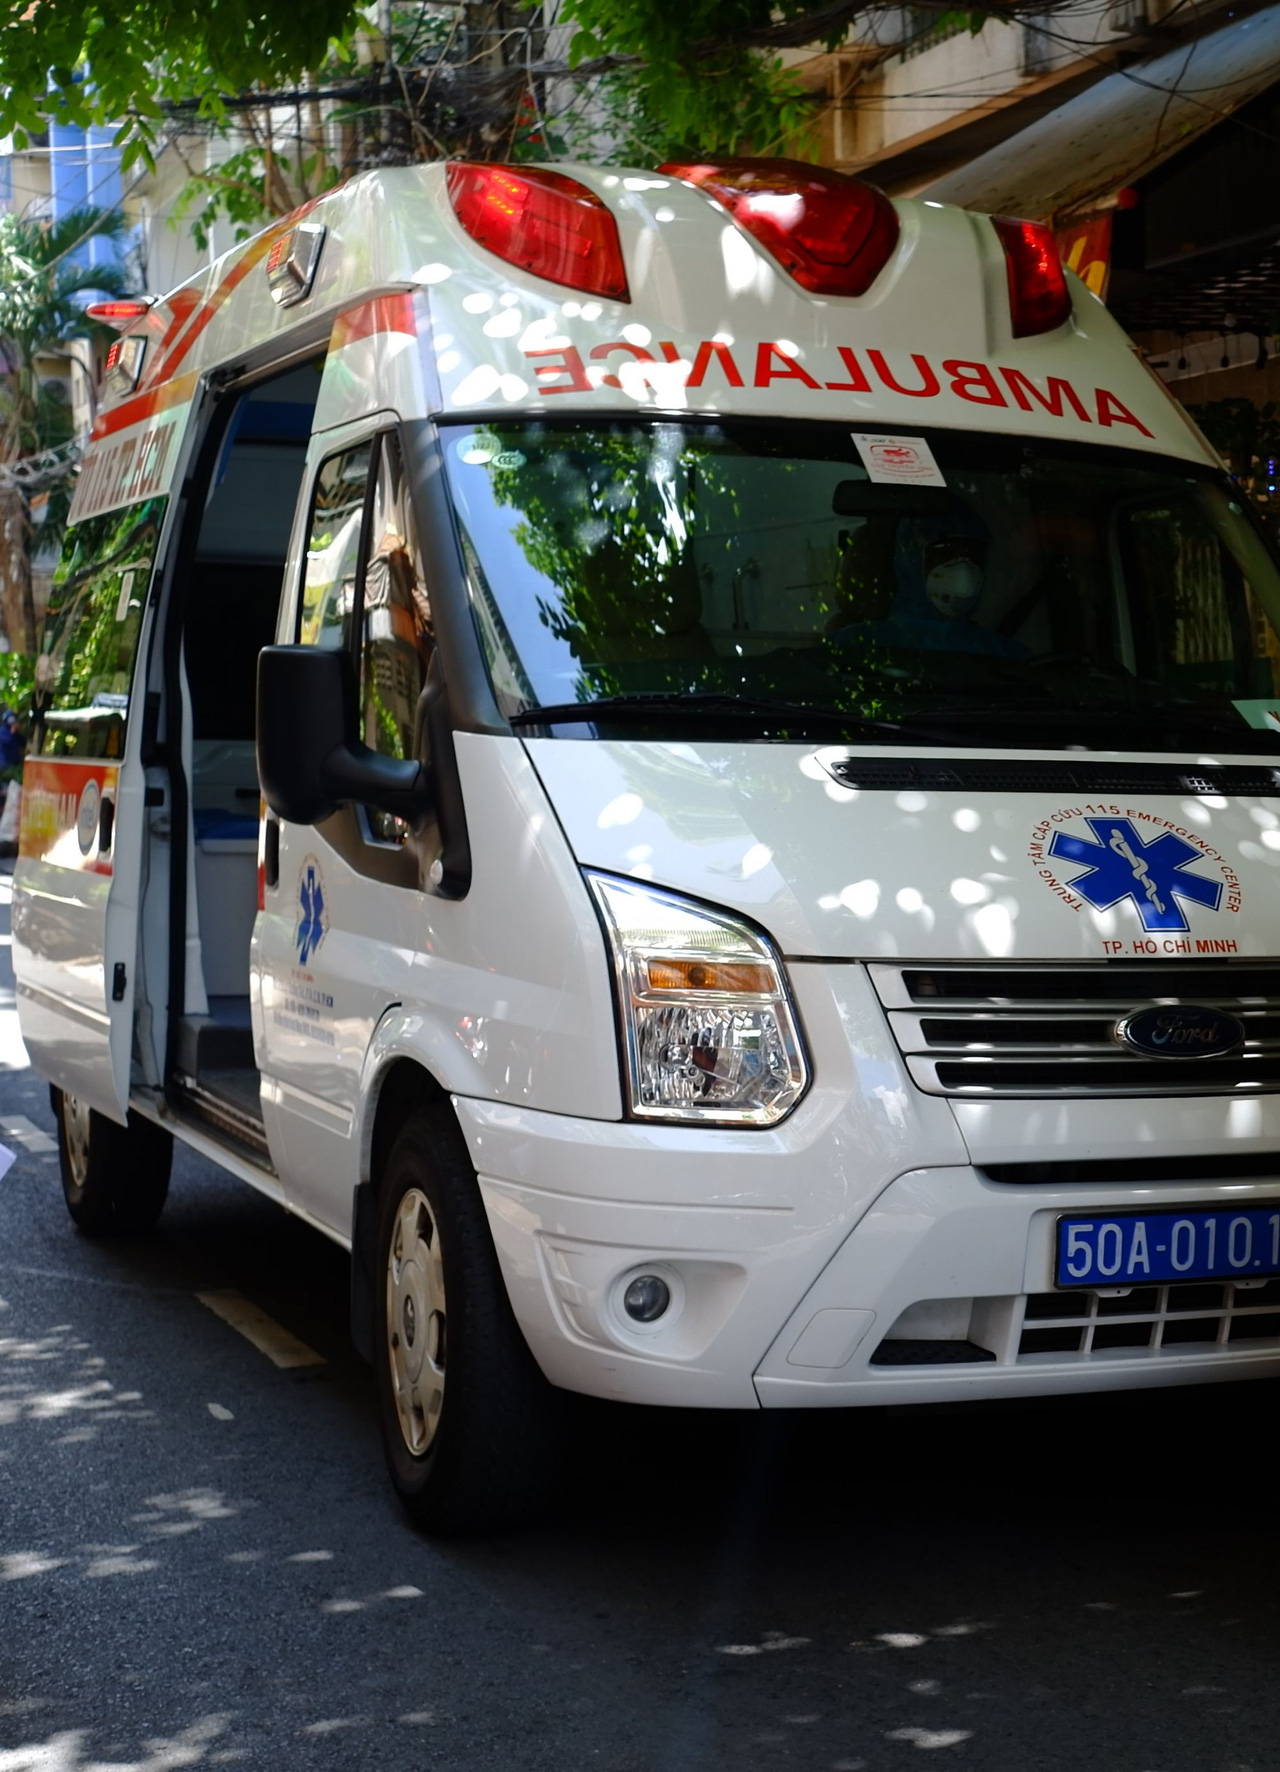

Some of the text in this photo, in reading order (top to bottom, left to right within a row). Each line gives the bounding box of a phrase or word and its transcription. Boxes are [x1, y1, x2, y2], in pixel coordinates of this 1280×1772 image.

[1085, 804, 1120, 815] 115
[1126, 809, 1226, 863] EMERGENCY
[1027, 842, 1046, 866] TÂM
[1039, 869, 1083, 912] TRUNG
[1220, 866, 1242, 914] CENTER
[1163, 936, 1192, 954] CHÍ
[1196, 939, 1238, 954] MINH
[1151, 1013, 1219, 1045] Ford
